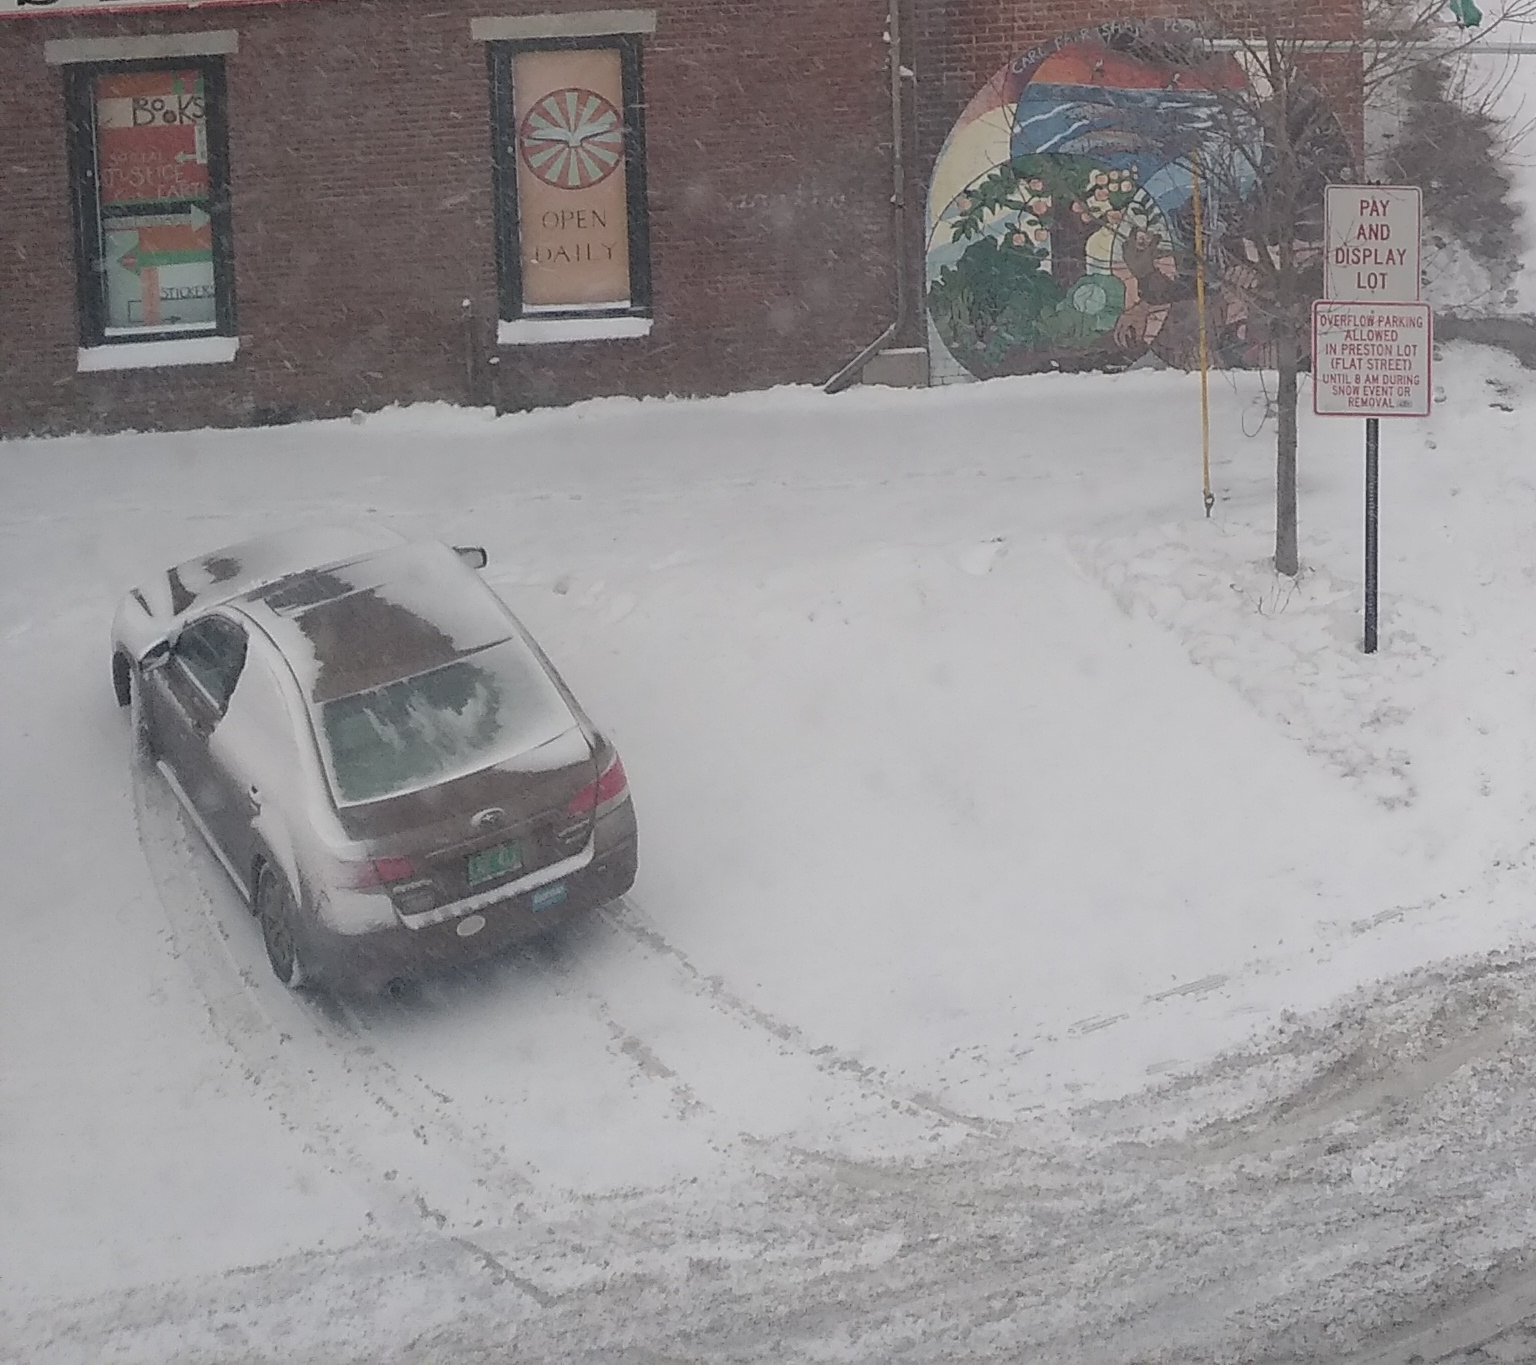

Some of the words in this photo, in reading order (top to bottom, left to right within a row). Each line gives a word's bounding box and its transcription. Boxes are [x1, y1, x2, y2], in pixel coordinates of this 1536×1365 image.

[102, 163, 184, 188] JUSTICE
[1360, 199, 1390, 217] PAY
[542, 210, 606, 229] OPEN
[1357, 223, 1391, 241] AND
[535, 241, 618, 262] DAILY
[1335, 247, 1407, 265] DISPLAY
[1357, 271, 1388, 290] LOT
[1320, 314, 1375, 327] OVERFLOW
[1378, 316, 1423, 328] PARKING
[1344, 329, 1398, 342] ALLOWED
[1325, 343, 1337, 355] IN
[1341, 343, 1393, 356] PRESTON
[1397, 344, 1417, 357] LOT
[1331, 357, 1363, 370] (FLAT
[1366, 358, 1412, 371] STREET)
[1322, 373, 1351, 384] UNTIL
[1354, 374, 1361, 384] 8
[1364, 374, 1379, 385] AM
[1382, 375, 1420, 386] DURING
[1332, 385, 1360, 396] SNOW
[1363, 385, 1394, 396] EVENT
[1397, 386, 1411, 397] OR
[1348, 396, 1395, 408] REMOVAL
